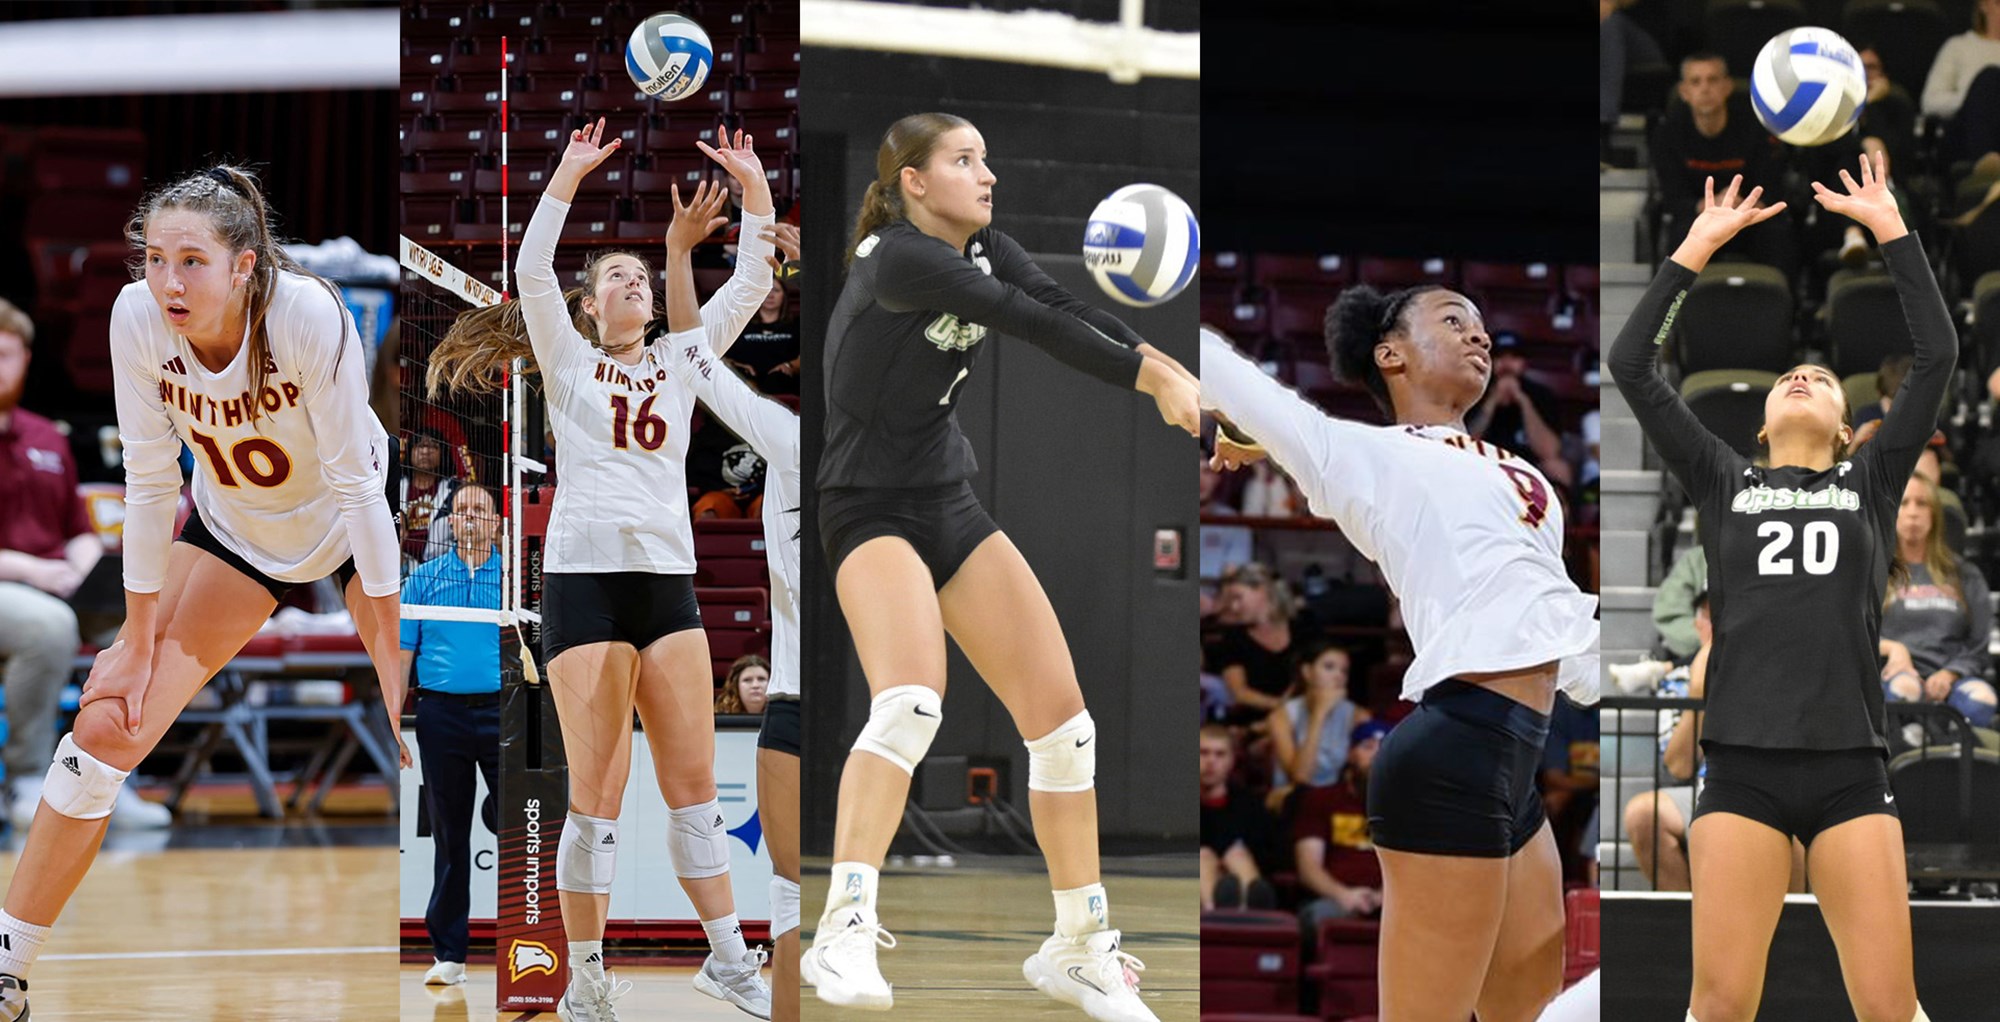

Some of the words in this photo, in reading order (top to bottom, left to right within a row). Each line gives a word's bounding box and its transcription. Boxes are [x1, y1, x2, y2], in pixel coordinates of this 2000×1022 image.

[645, 63, 681, 95] molten
[158, 377, 300, 428] WINTHROP
[609, 392, 669, 453] 16
[188, 425, 294, 489] 10
[531, 550, 542, 591] sports
[1757, 521, 1839, 575] 20
[524, 798, 542, 854] sports
[523, 856, 541, 925] imports
